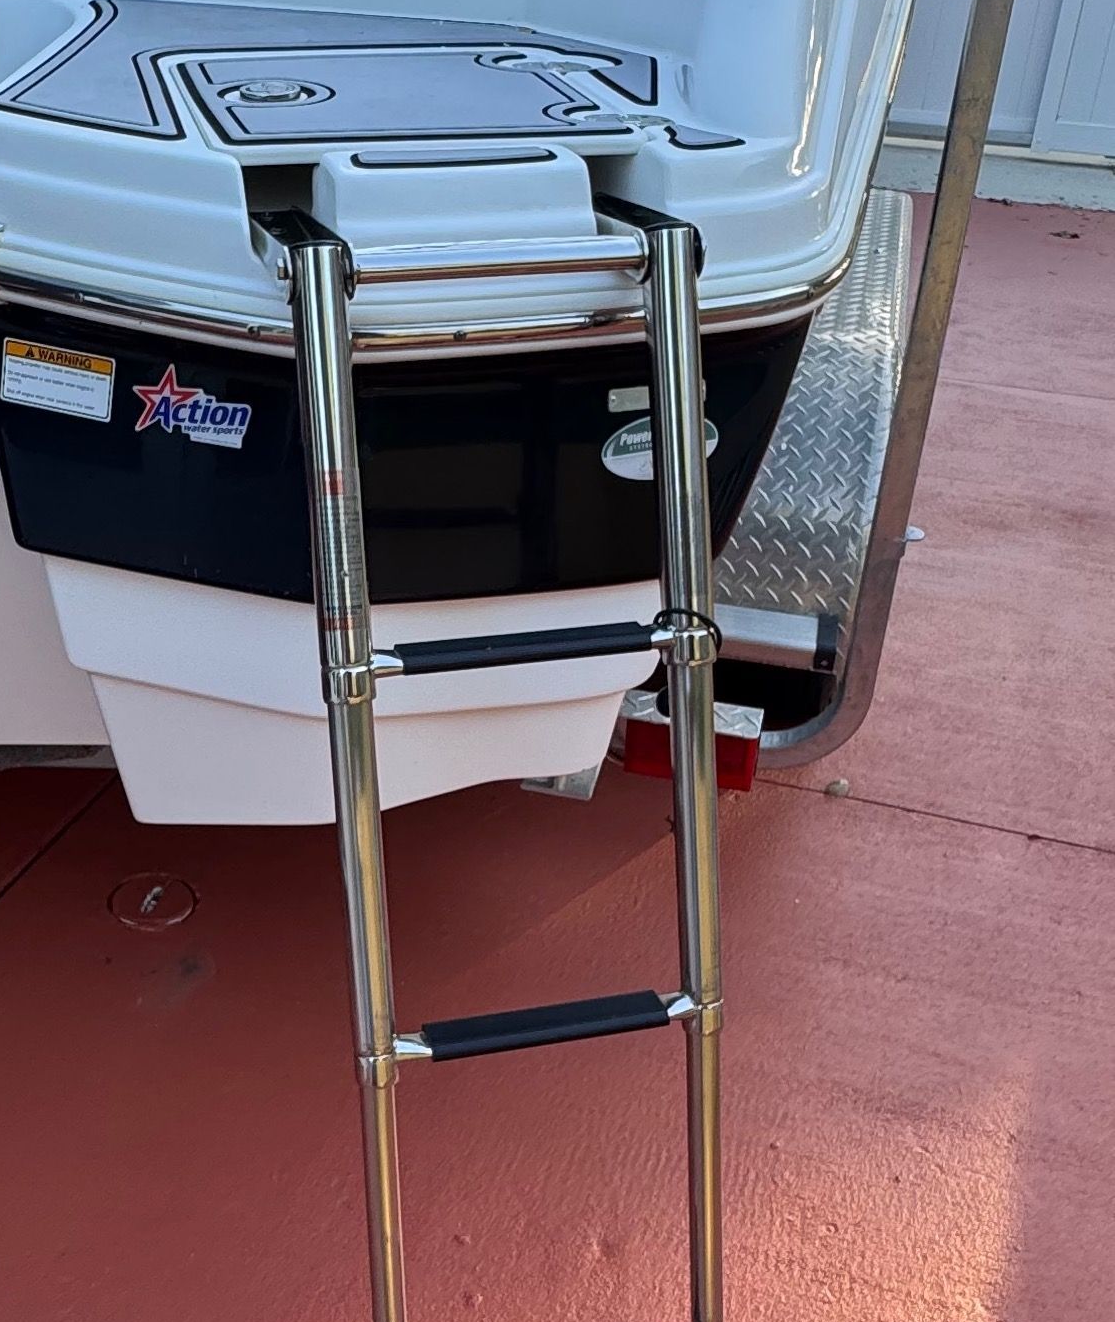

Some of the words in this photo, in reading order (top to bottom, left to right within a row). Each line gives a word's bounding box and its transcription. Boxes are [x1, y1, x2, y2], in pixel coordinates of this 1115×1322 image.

[39, 348, 92, 369] WARNING
[149, 395, 249, 430] Action
[183, 424, 212, 434] water
[213, 426, 245, 437] sports
